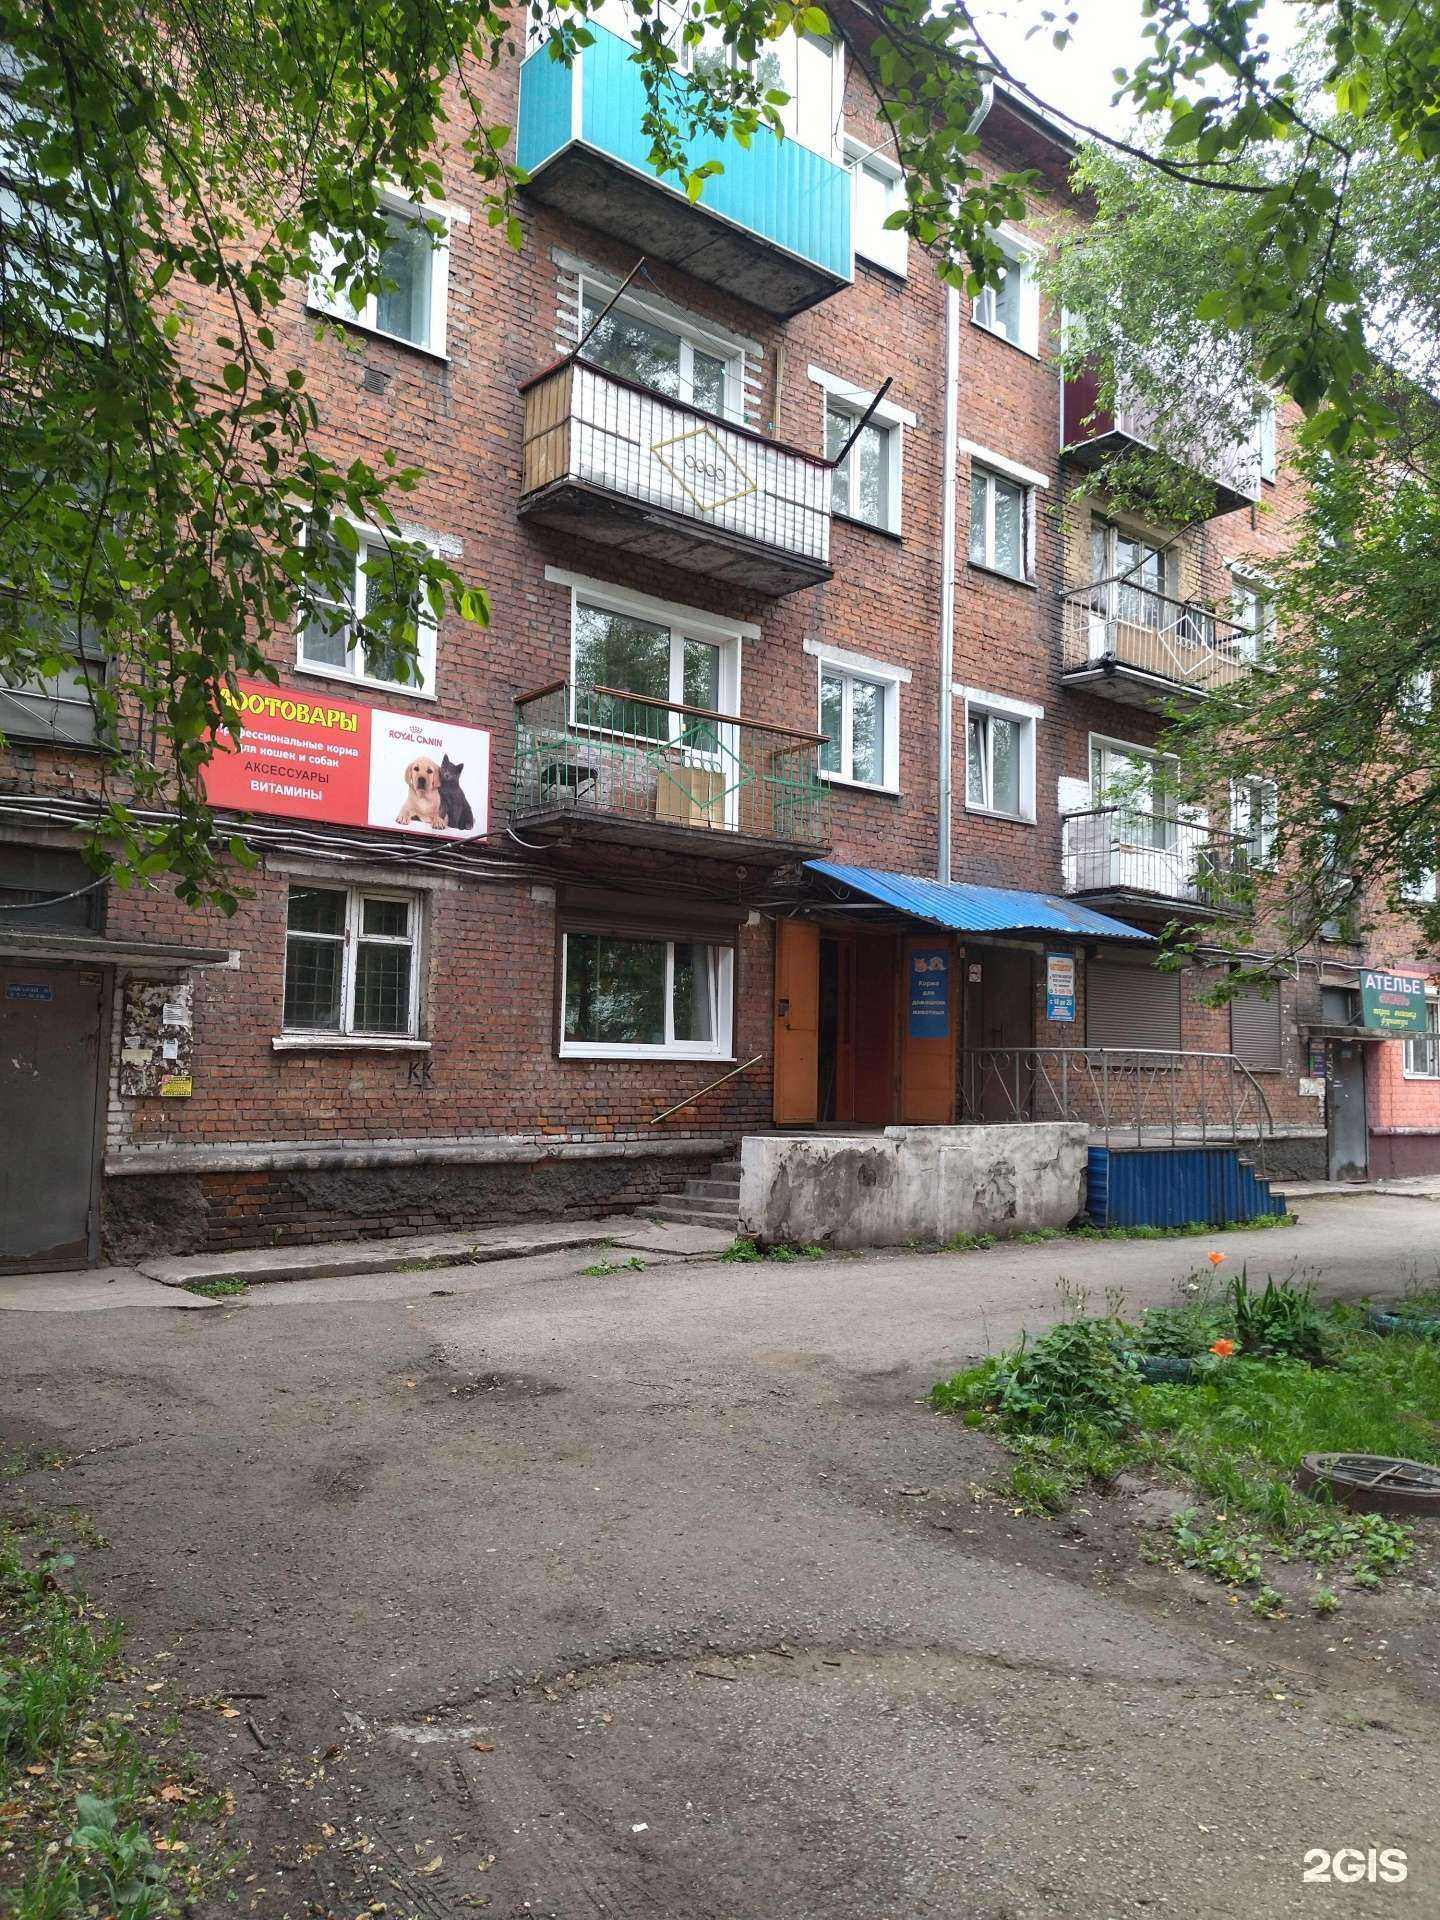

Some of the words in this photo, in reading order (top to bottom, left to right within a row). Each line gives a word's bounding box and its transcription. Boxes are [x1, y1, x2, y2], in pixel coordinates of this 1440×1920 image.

[389, 729, 415, 742] ROYAL
[416, 735, 443, 747] CANIN
[260, 747, 296, 760] кошек
[298, 754, 307, 763] и
[308, 755, 340, 768] собак
[326, 744, 359, 758] корма
[244, 760, 330, 784] АКСЕССУАРЫ
[249, 779, 323, 801] ВИТАМИНЫ
[1365, 974, 1421, 994] АТЕЛЬЕ
